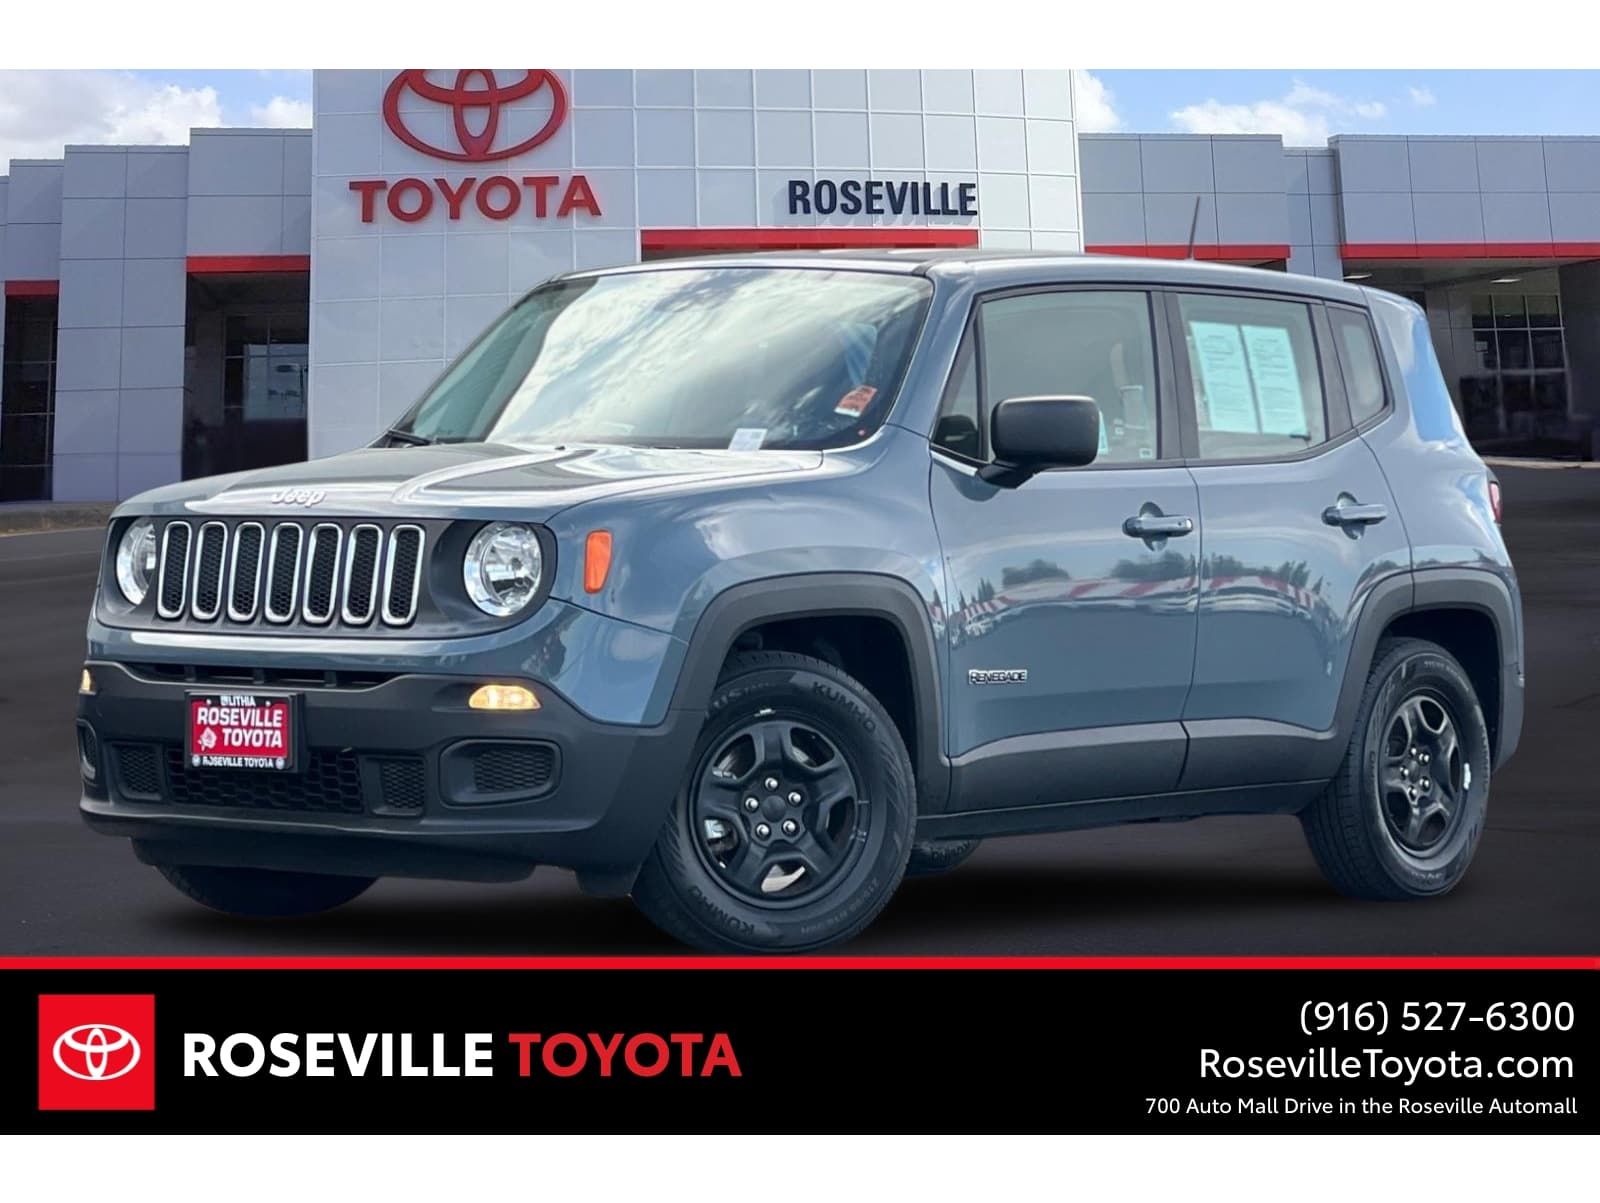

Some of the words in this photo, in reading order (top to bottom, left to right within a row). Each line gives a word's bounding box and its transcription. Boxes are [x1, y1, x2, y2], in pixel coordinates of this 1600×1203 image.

[349, 175, 602, 223] TOYOTA
[788, 179, 978, 216] ROSEVILLE
[271, 488, 327, 508] Jeep
[968, 669, 1028, 684] RENEGADE
[228, 695, 256, 707] LITHIA
[812, 681, 877, 733] KUMHO
[197, 707, 283, 728] ROSEVILLE
[222, 728, 282, 748] TOYOTA
[202, 756, 242, 767] ROSEVILLE
[243, 757, 274, 768] TOYOTA
